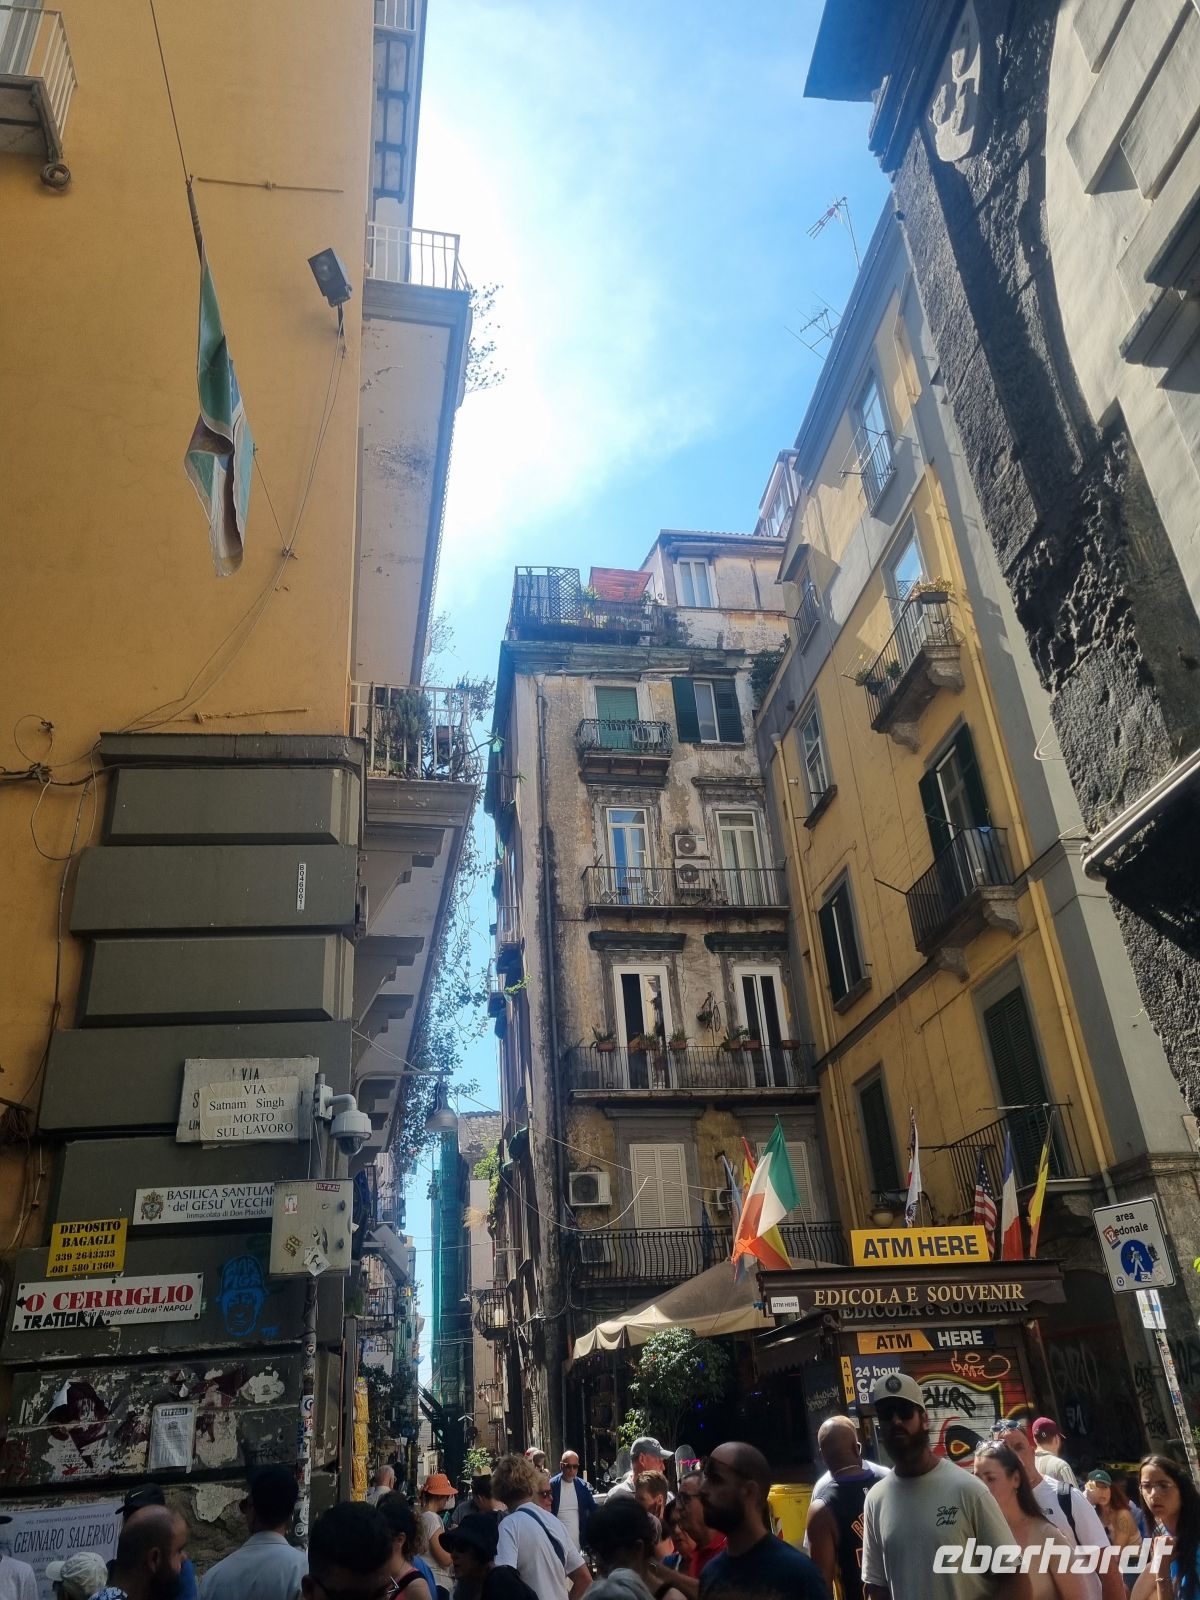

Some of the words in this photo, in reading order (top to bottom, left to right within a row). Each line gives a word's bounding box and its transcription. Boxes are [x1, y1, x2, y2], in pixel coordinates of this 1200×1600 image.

[242, 1067, 260, 1081] VIA
[244, 1084, 266, 1095] VIA
[209, 1100, 247, 1112] Satnam
[256, 1097, 285, 1110] Singh
[233, 1112, 275, 1124] MORTO
[216, 1128, 239, 1138] SUL
[245, 1122, 294, 1135] LAVORO
[167, 1188, 218, 1201] BASILICA
[173, 1201, 188, 1212] del
[1115, 1212, 1135, 1222] area
[60, 1220, 121, 1235] DEPOSITO
[1115, 1222, 1149, 1236] edonale
[62, 1234, 115, 1248] BAGAGLI
[863, 1237, 913, 1259] ATM
[917, 1234, 980, 1257] HERE
[55, 1252, 73, 1262] 339
[52, 1284, 194, 1311] CERRIGLIO
[813, 1287, 901, 1306] EDICOLA
[905, 1286, 919, 1303] E
[927, 1283, 1025, 1303] SOUVENIR
[98, 1308, 122, 1318] Biagio
[123, 1306, 136, 1315] dei
[163, 1303, 193, 1313] NAPOLI
[876, 1332, 913, 1350] ATM
[937, 1329, 984, 1347] HERE
[843, 1360, 855, 1396] ATM
[854, 1366, 871, 1378] 24
[872, 1364, 900, 1377] hour
[13, 1528, 65, 1554] GENNARO
[66, 1523, 115, 1549] SALERNO
